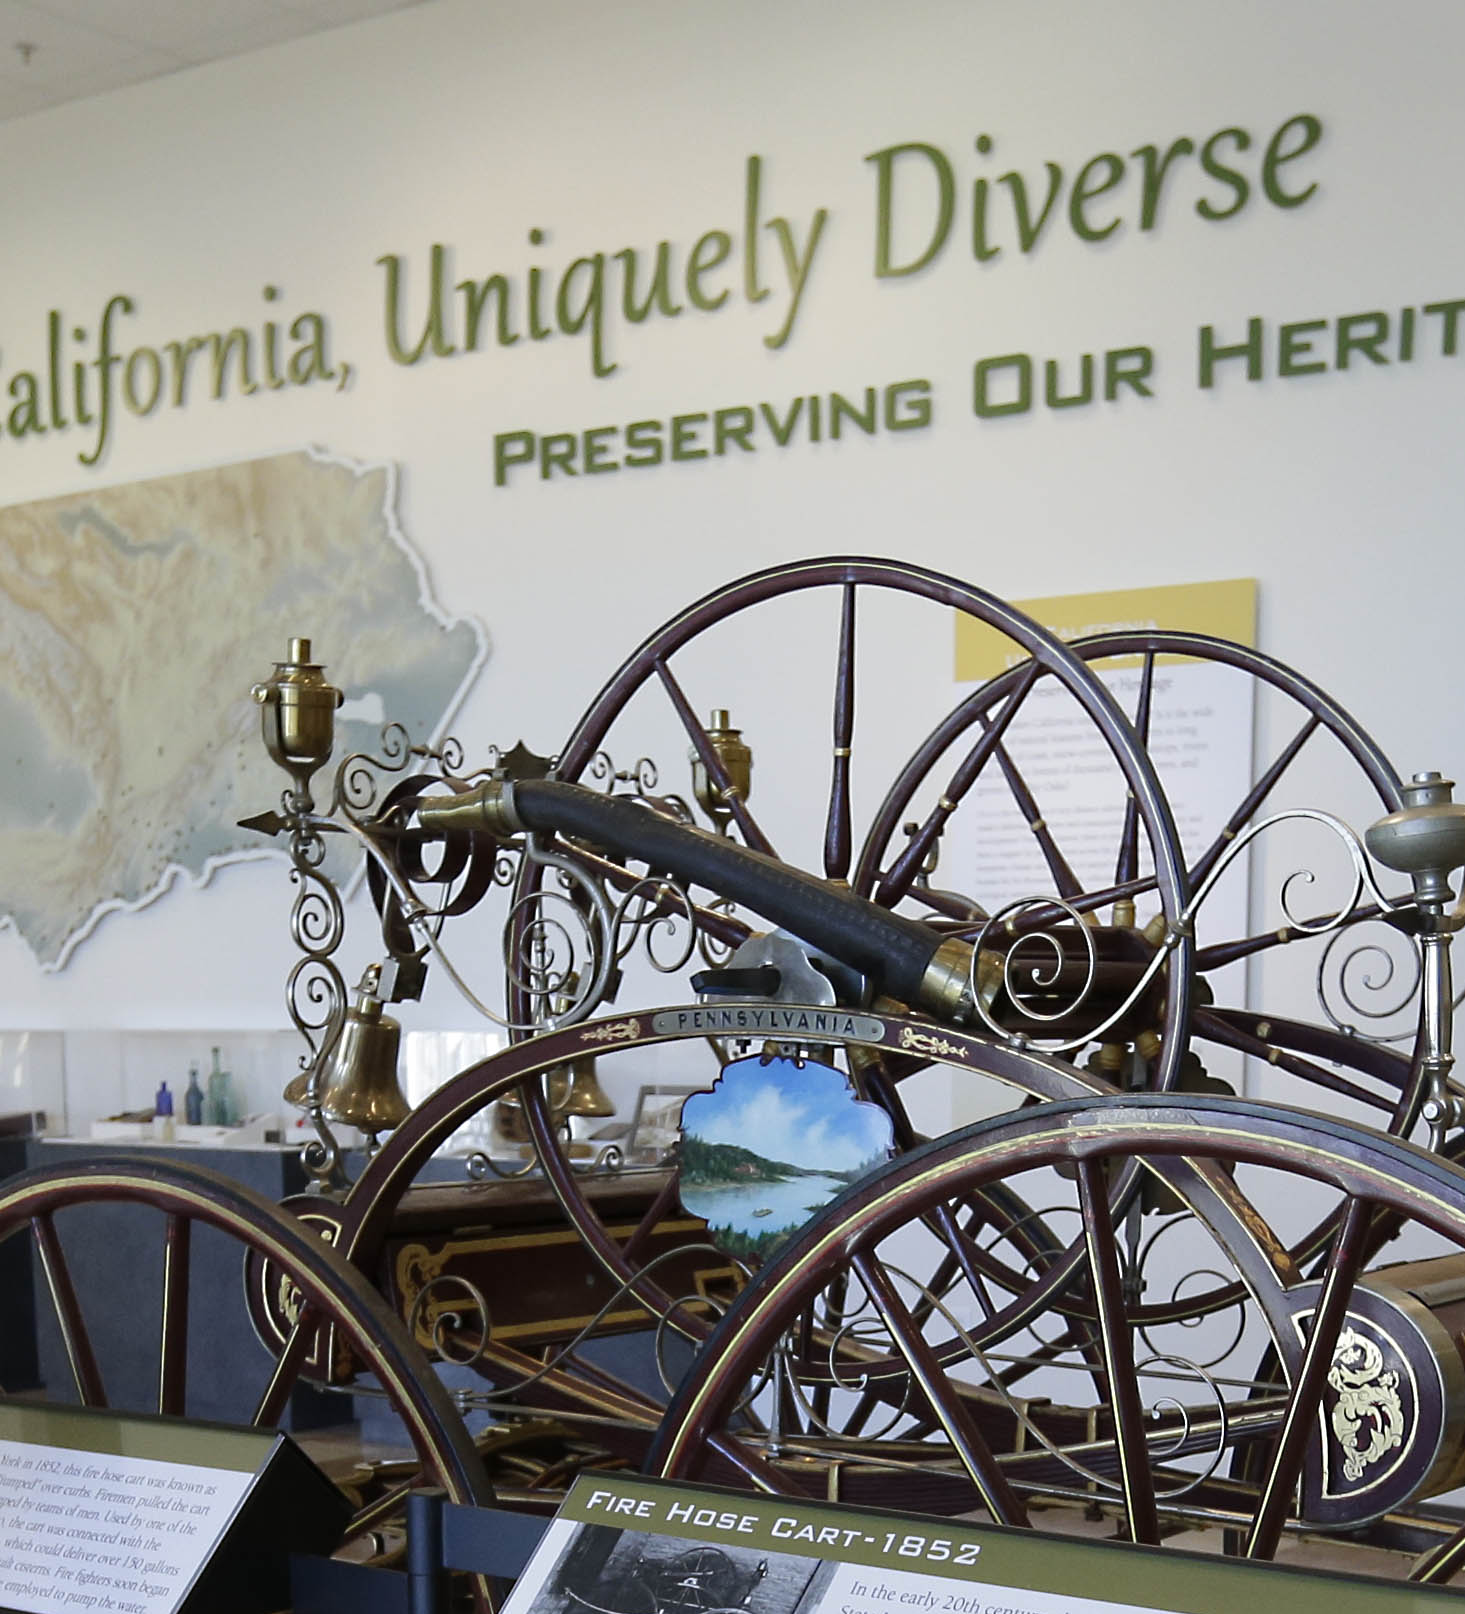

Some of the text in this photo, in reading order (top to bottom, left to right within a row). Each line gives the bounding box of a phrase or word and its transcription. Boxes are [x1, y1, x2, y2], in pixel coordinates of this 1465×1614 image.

[379, 153, 828, 376] Uniquely
[865, 113, 1322, 277] Diverse
[495, 379, 933, 487] PRESERVING
[973, 345, 1154, 416] OUR
[678, 1011, 857, 1035] PENNSYLVANIA
[0, 1453, 22, 1469] York
[22, 1460, 34, 1470] in
[62, 1462, 83, 1478] this
[82, 1464, 101, 1480] fire
[99, 1467, 126, 1483] hose
[124, 1474, 147, 1486] cart
[146, 1477, 168, 1489] was
[166, 1476, 205, 1495] known
[203, 1485, 218, 1496] as
[21, 1496, 37, 1510] by
[34, 1501, 66, 1515] teams
[64, 1503, 81, 1517] of
[103, 1509, 133, 1526] Used
[129, 1513, 147, 1531] by
[145, 1520, 167, 1531] one
[165, 1519, 184, 1533] of
[178, 1520, 198, 1536] the
[40, 1484, 65, 1495] over
[170, 1498, 190, 1513] the
[188, 1504, 212, 1517] cart
[8, 1515, 26, 1530] the
[24, 1521, 46, 1534] cart
[46, 1524, 67, 1537] was
[118, 1534, 143, 1549] with
[142, 1536, 163, 1552] the
[586, 1490, 981, 1566] FIRE HOSE CART-1852
[3, 1535, 34, 1552] which
[33, 1542, 66, 1558] could
[96, 1554, 123, 1567] over
[52, 1589, 66, 1601] to
[62, 1592, 98, 1610] pump
[97, 1594, 117, 1610] the
[53, 1565, 75, 1581] Fire
[111, 1578, 139, 1592] soon
[137, 1579, 171, 1599] began
[849, 1580, 868, 1597] In
[870, 1583, 897, 1602] the
[899, 1590, 940, 1612] early
[941, 1594, 981, 1614] 20th
